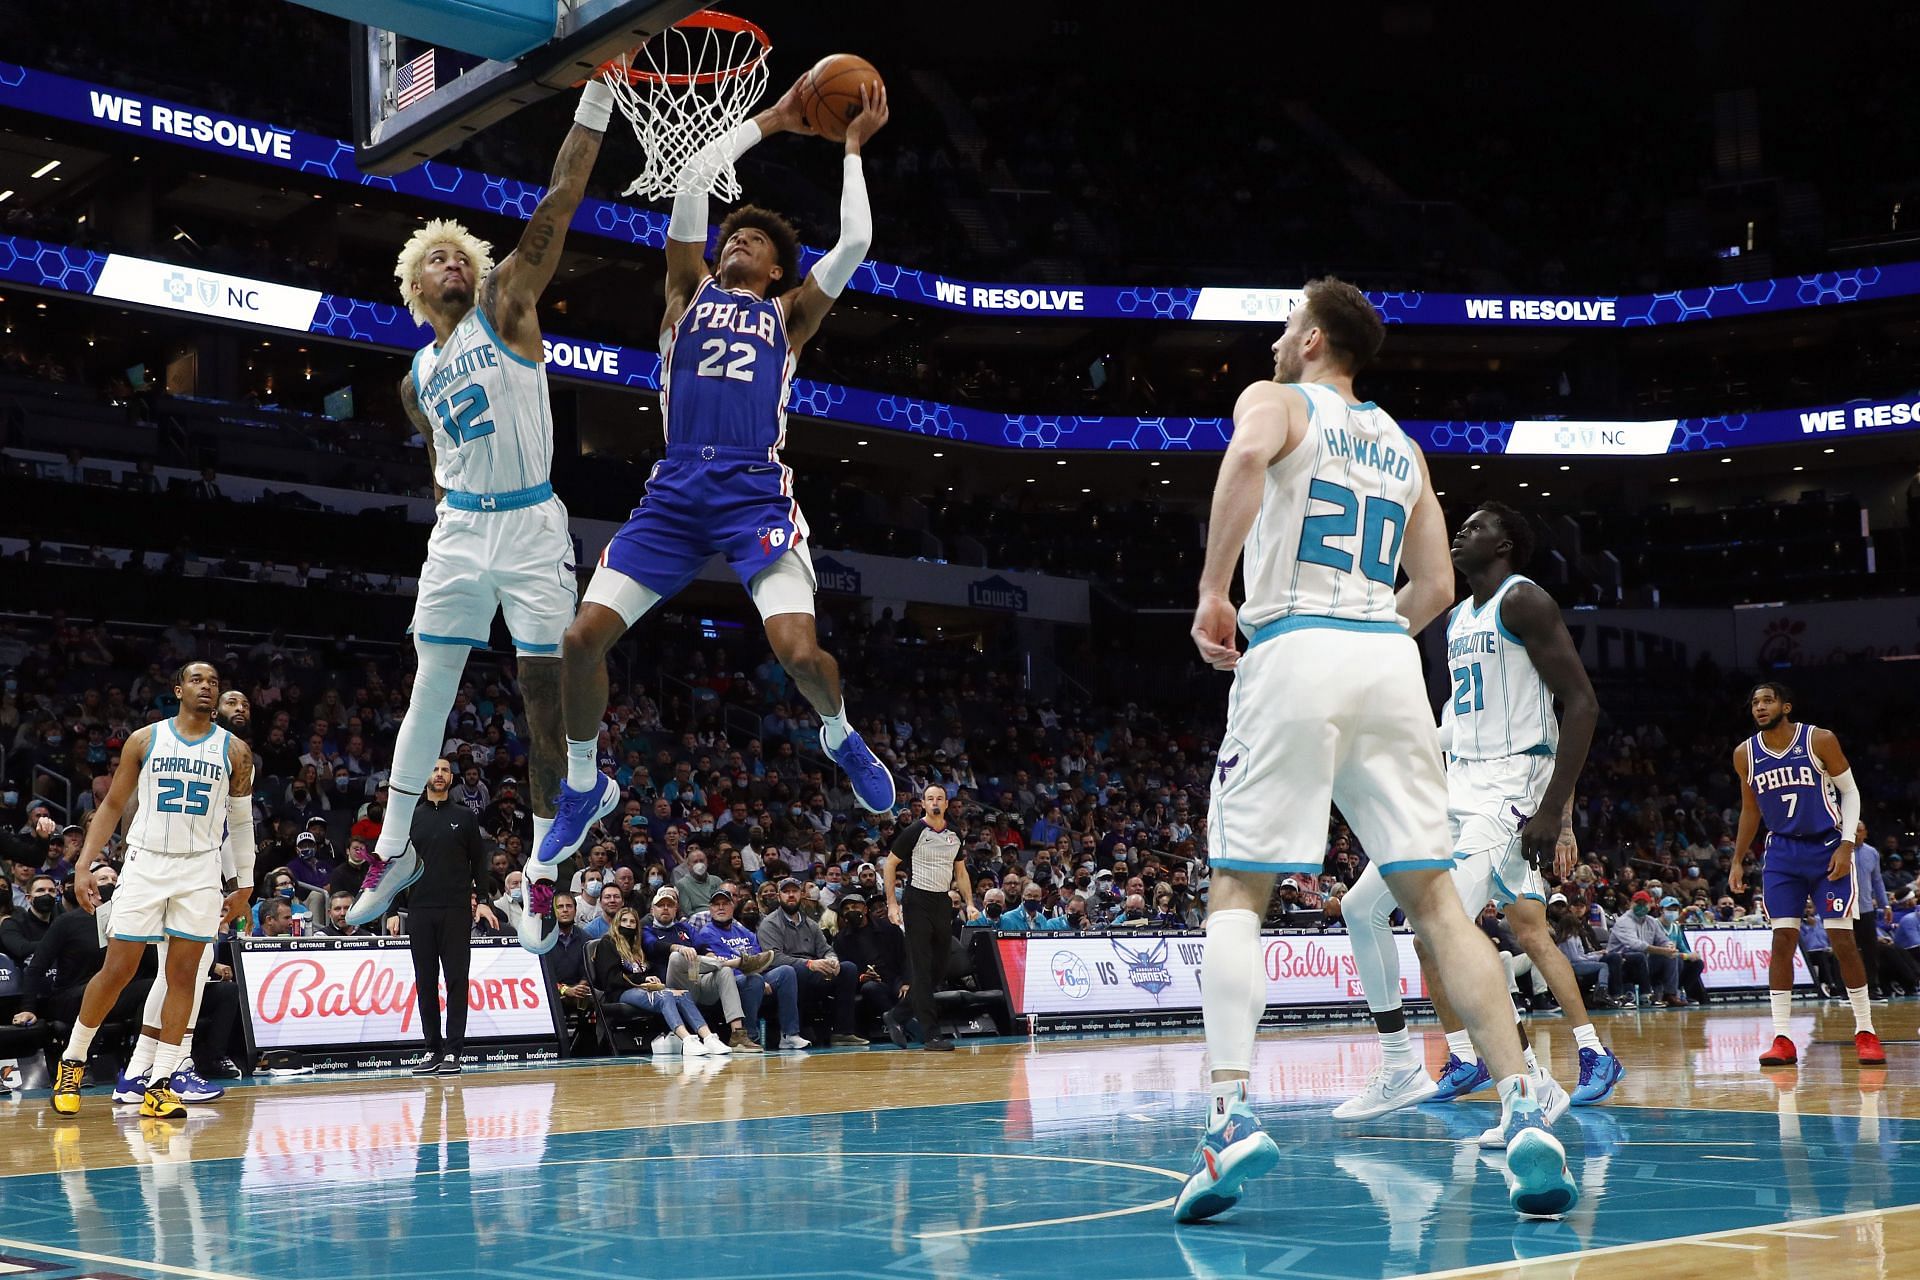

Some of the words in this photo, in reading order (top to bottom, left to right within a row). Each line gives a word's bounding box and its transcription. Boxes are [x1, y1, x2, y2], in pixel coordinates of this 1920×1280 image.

[90, 91, 142, 126] WE
[152, 105, 292, 160] RESOLVE
[228, 287, 260, 311] NC
[935, 281, 966, 305] WE
[972, 288, 1084, 311] RESOLVE
[1289, 298, 1300, 312] N
[1465, 299, 1503, 319] WE
[1509, 300, 1616, 321] RESOLVE
[690, 302, 775, 347] PHILA
[543, 340, 619, 375] SOLVE
[697, 338, 757, 382] 22
[434, 383, 496, 448] 12
[1800, 410, 1846, 433] WE
[1602, 430, 1626, 446] NC
[1296, 477, 1406, 589] 20
[816, 571, 857, 592] WE'S
[973, 584, 1024, 609] LOWE'S
[1453, 661, 1484, 716] 21
[152, 757, 222, 781] CHARLOTTE
[1754, 766, 1816, 794] PHILA
[156, 778, 213, 816] 25
[1781, 793, 1798, 818] 7
[1265, 940, 1339, 989] Bally
[1693, 936, 1756, 981] Bally
[1055, 968, 1089, 987] 76ers
[1095, 962, 1118, 985] VS
[1130, 970, 1170, 984] HORNETS
[257, 959, 417, 1032] Bally
[968, 1020, 980, 1030] 24
[313, 1061, 349, 1069] lendingtree
[357, 1060, 392, 1068] lendingtree
[487, 1053, 519, 1061] lendingtree
[527, 1051, 558, 1060] lendingtree
